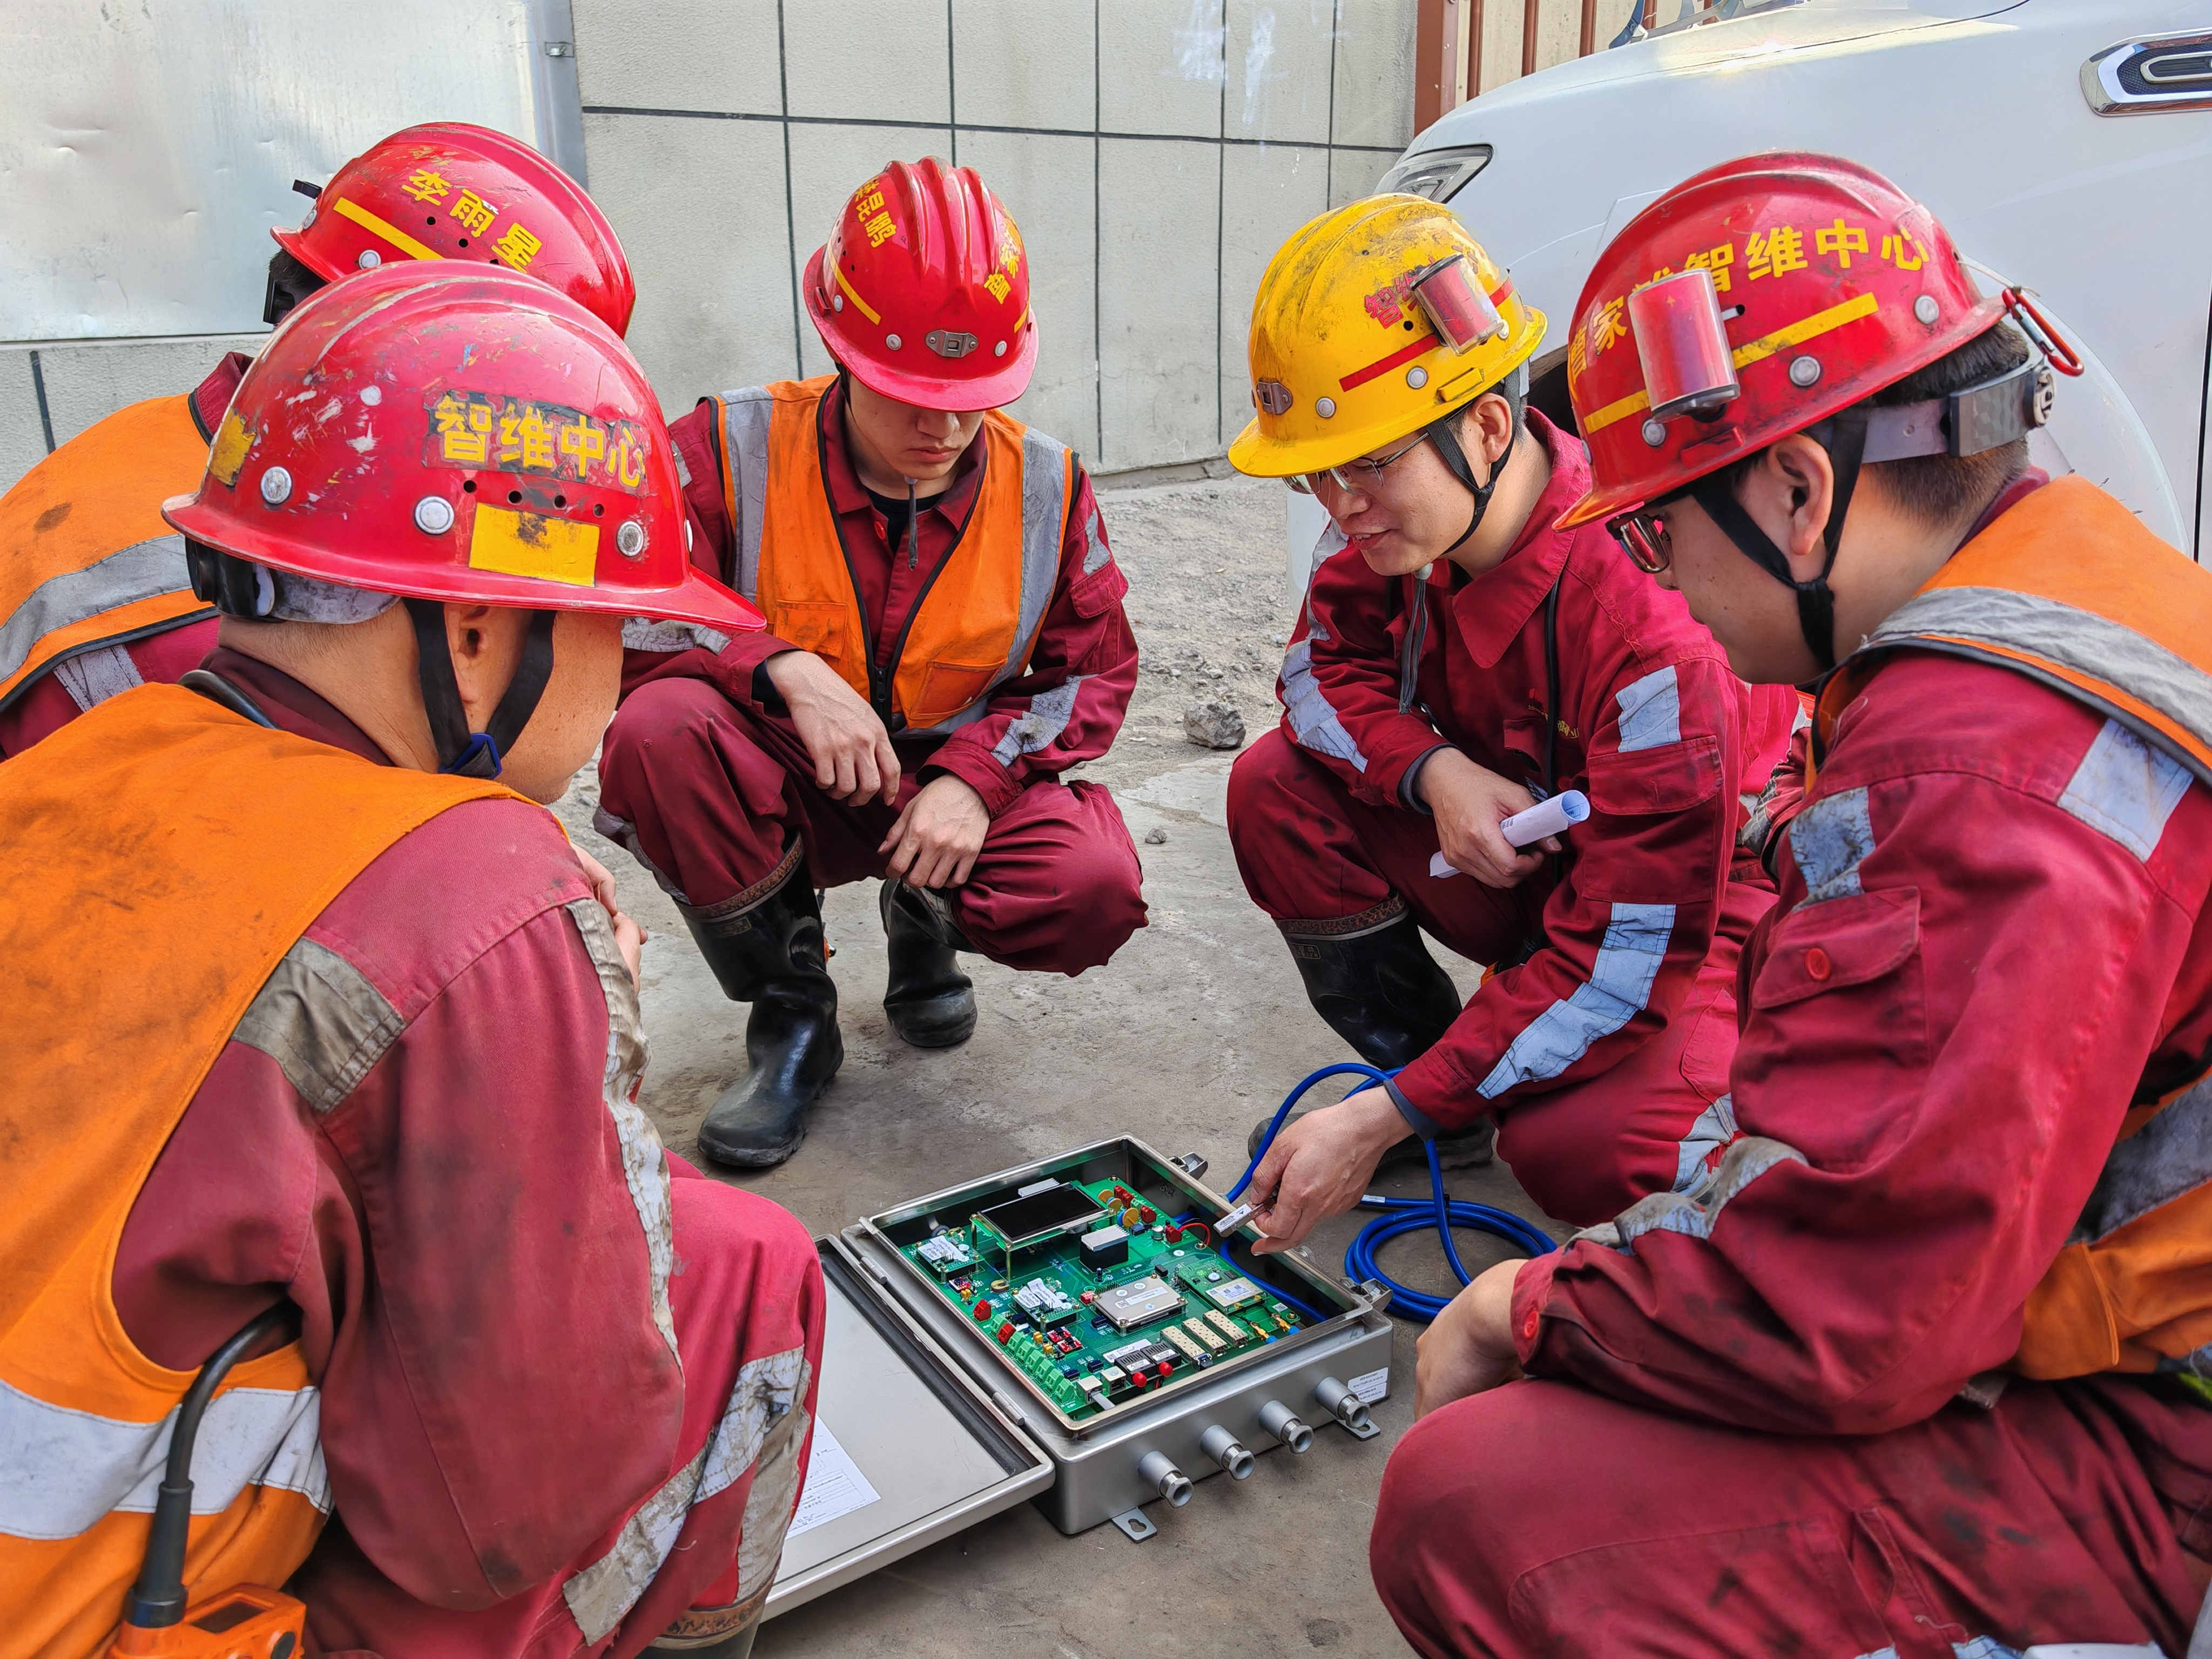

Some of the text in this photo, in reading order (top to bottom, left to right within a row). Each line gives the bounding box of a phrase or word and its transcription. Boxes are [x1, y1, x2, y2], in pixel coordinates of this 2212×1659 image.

[401, 168, 542, 274] 李雨星
[434, 395, 645, 488] 智维中心
